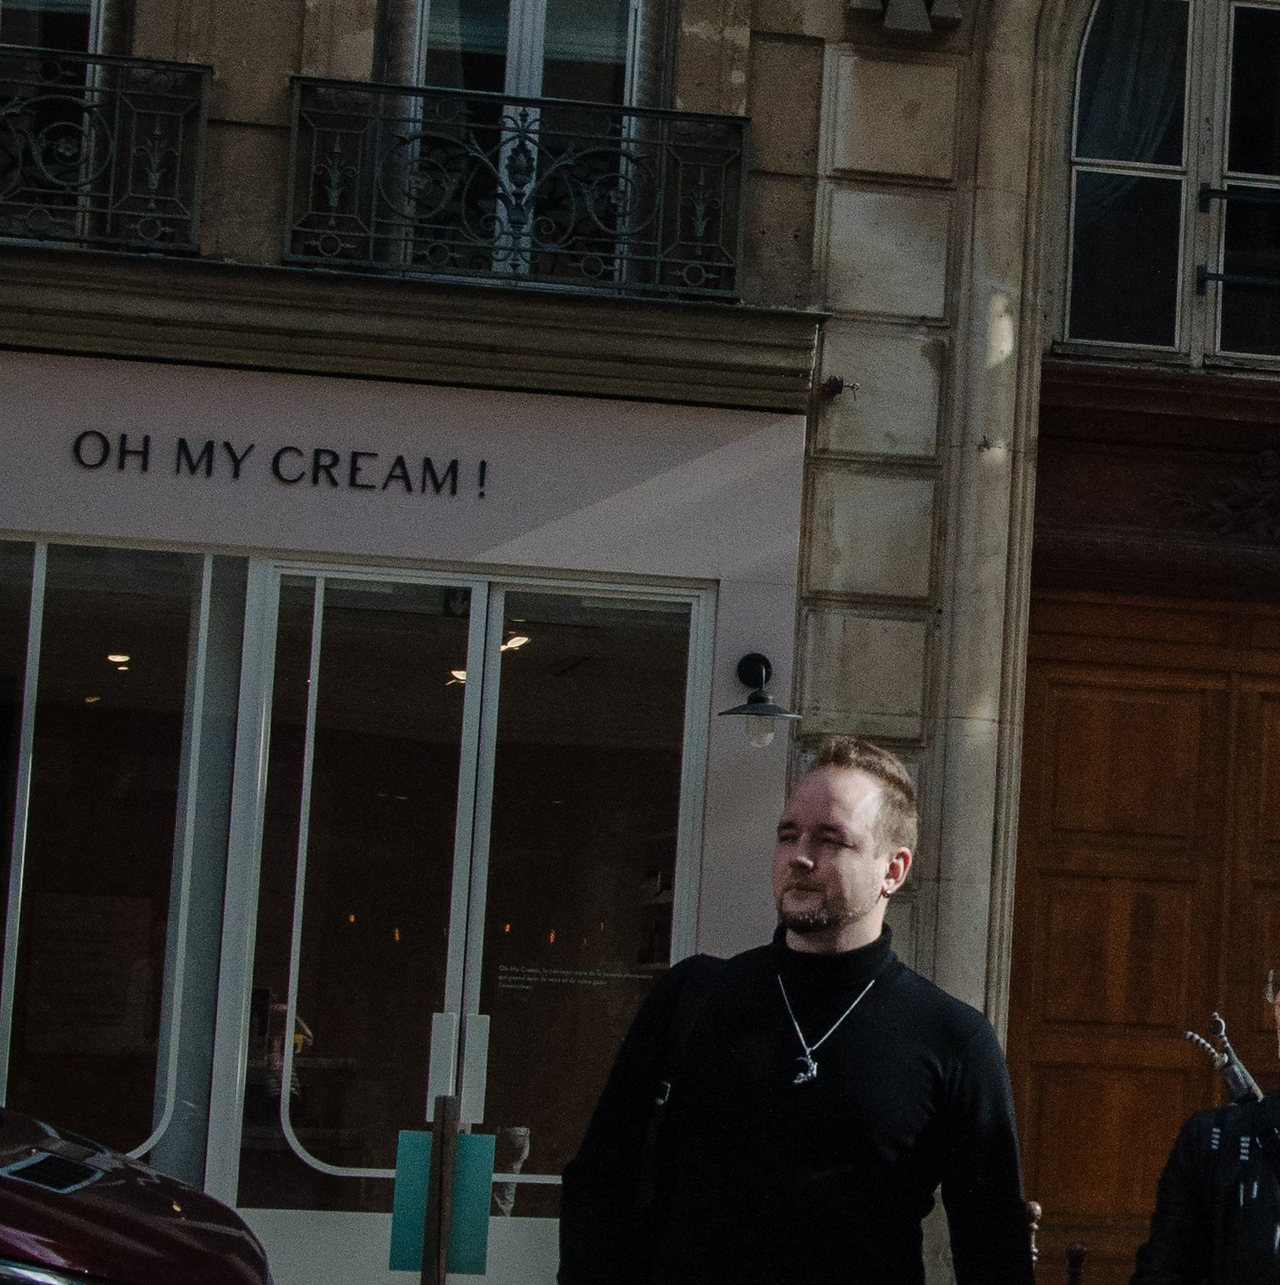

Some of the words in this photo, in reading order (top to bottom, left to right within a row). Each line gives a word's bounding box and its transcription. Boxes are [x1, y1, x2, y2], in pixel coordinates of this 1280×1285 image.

[70, 429, 151, 475] OH
[175, 437, 256, 481] MY
[270, 445, 460, 498] CREAM
[476, 459, 489, 500] !
